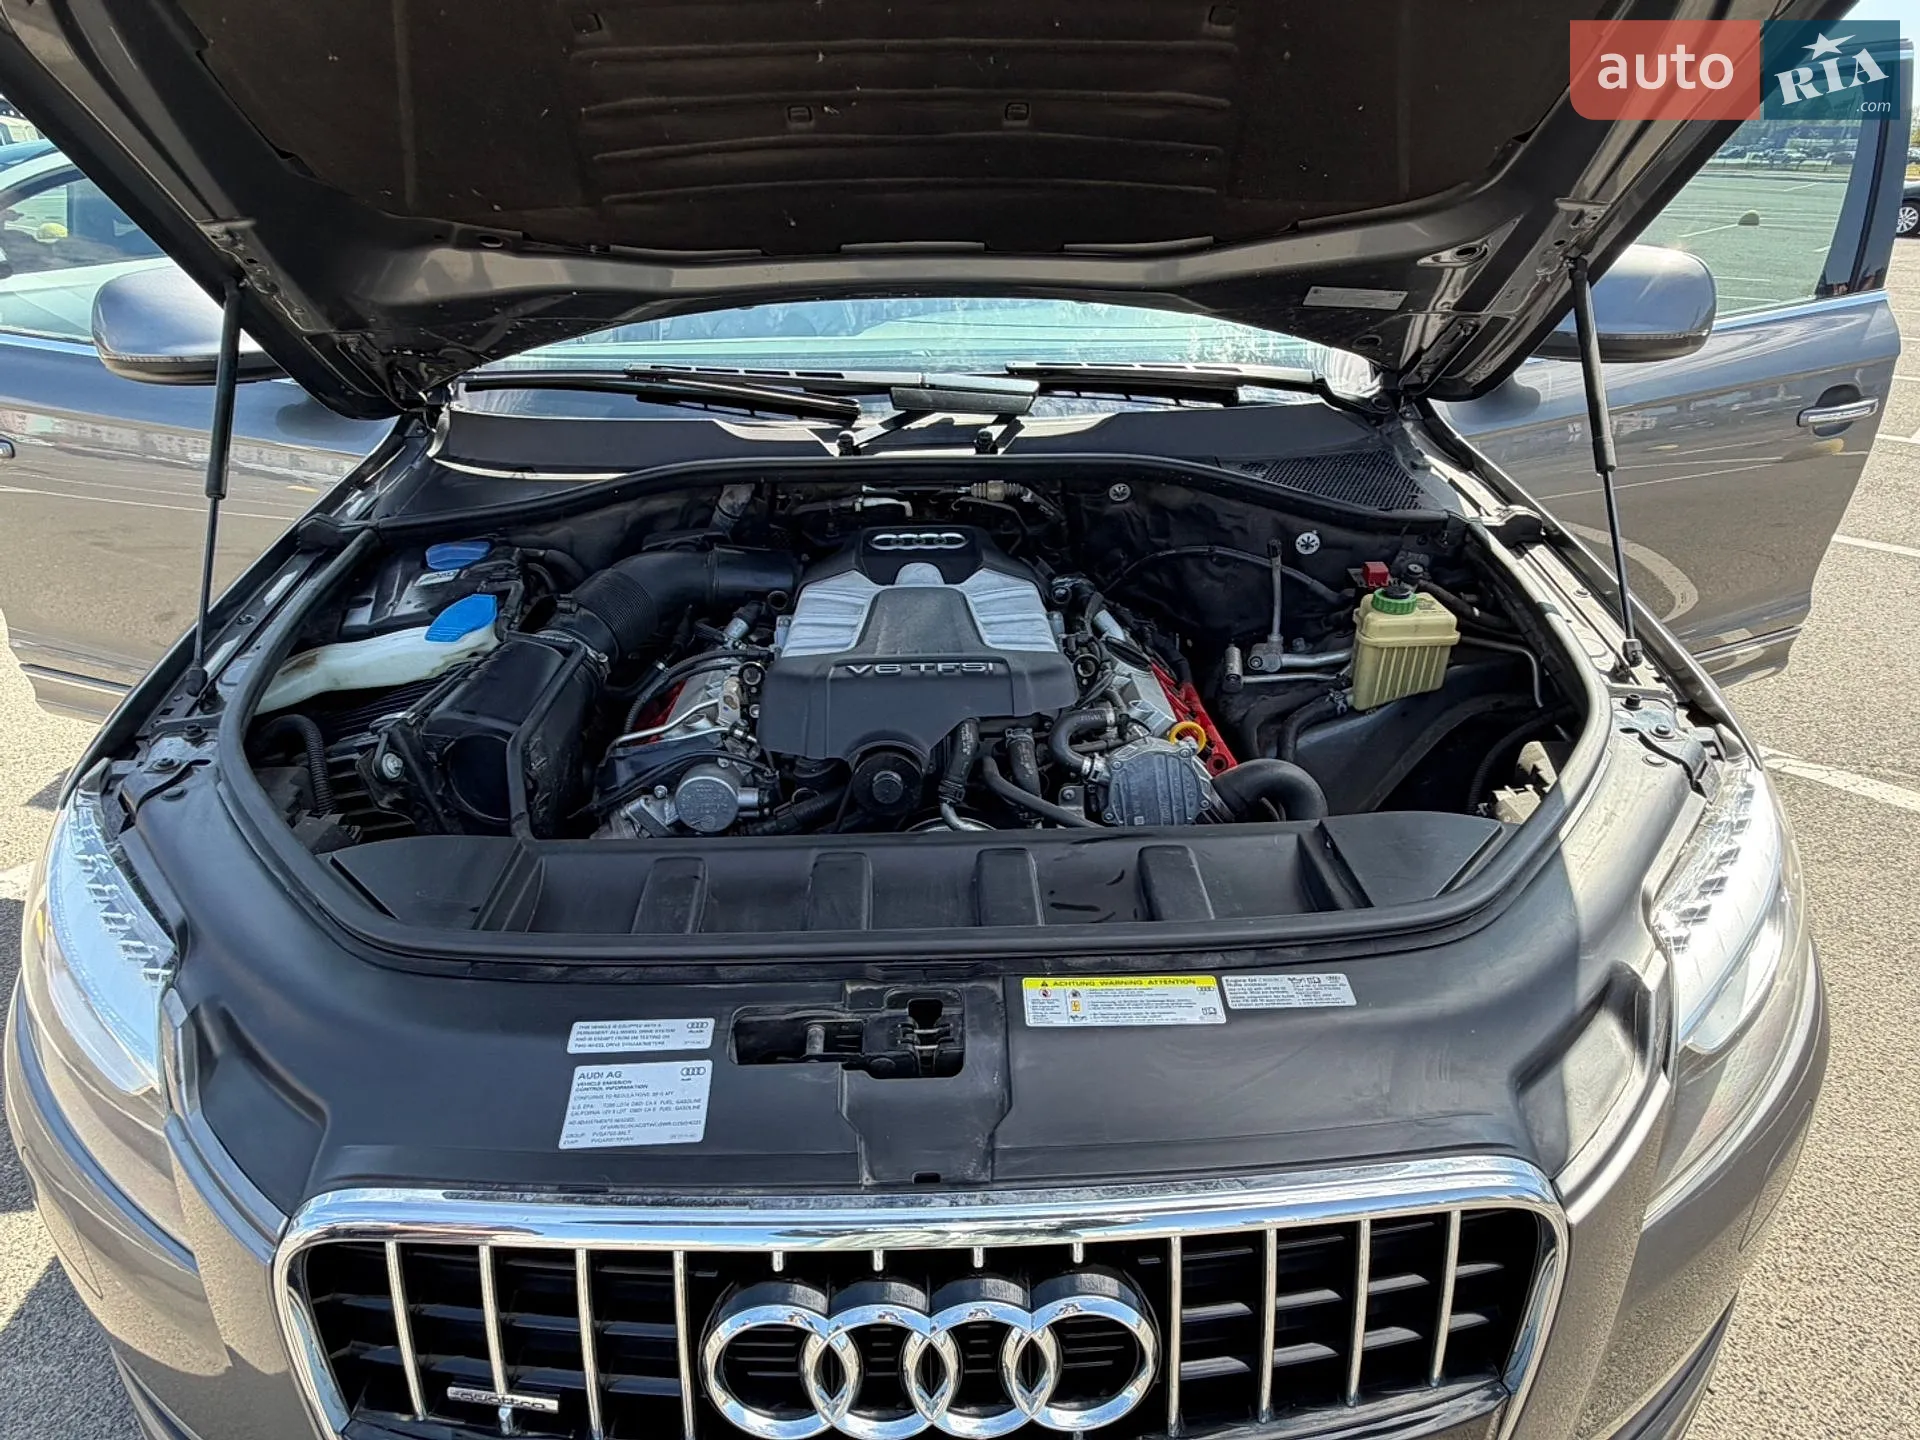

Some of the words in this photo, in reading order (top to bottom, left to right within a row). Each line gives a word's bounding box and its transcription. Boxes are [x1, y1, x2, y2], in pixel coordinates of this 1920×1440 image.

[847, 663, 902, 675] V6
[911, 662, 994, 674] TFSI
[577, 1071, 604, 1080] AUDI
[606, 1070, 623, 1079] AG
